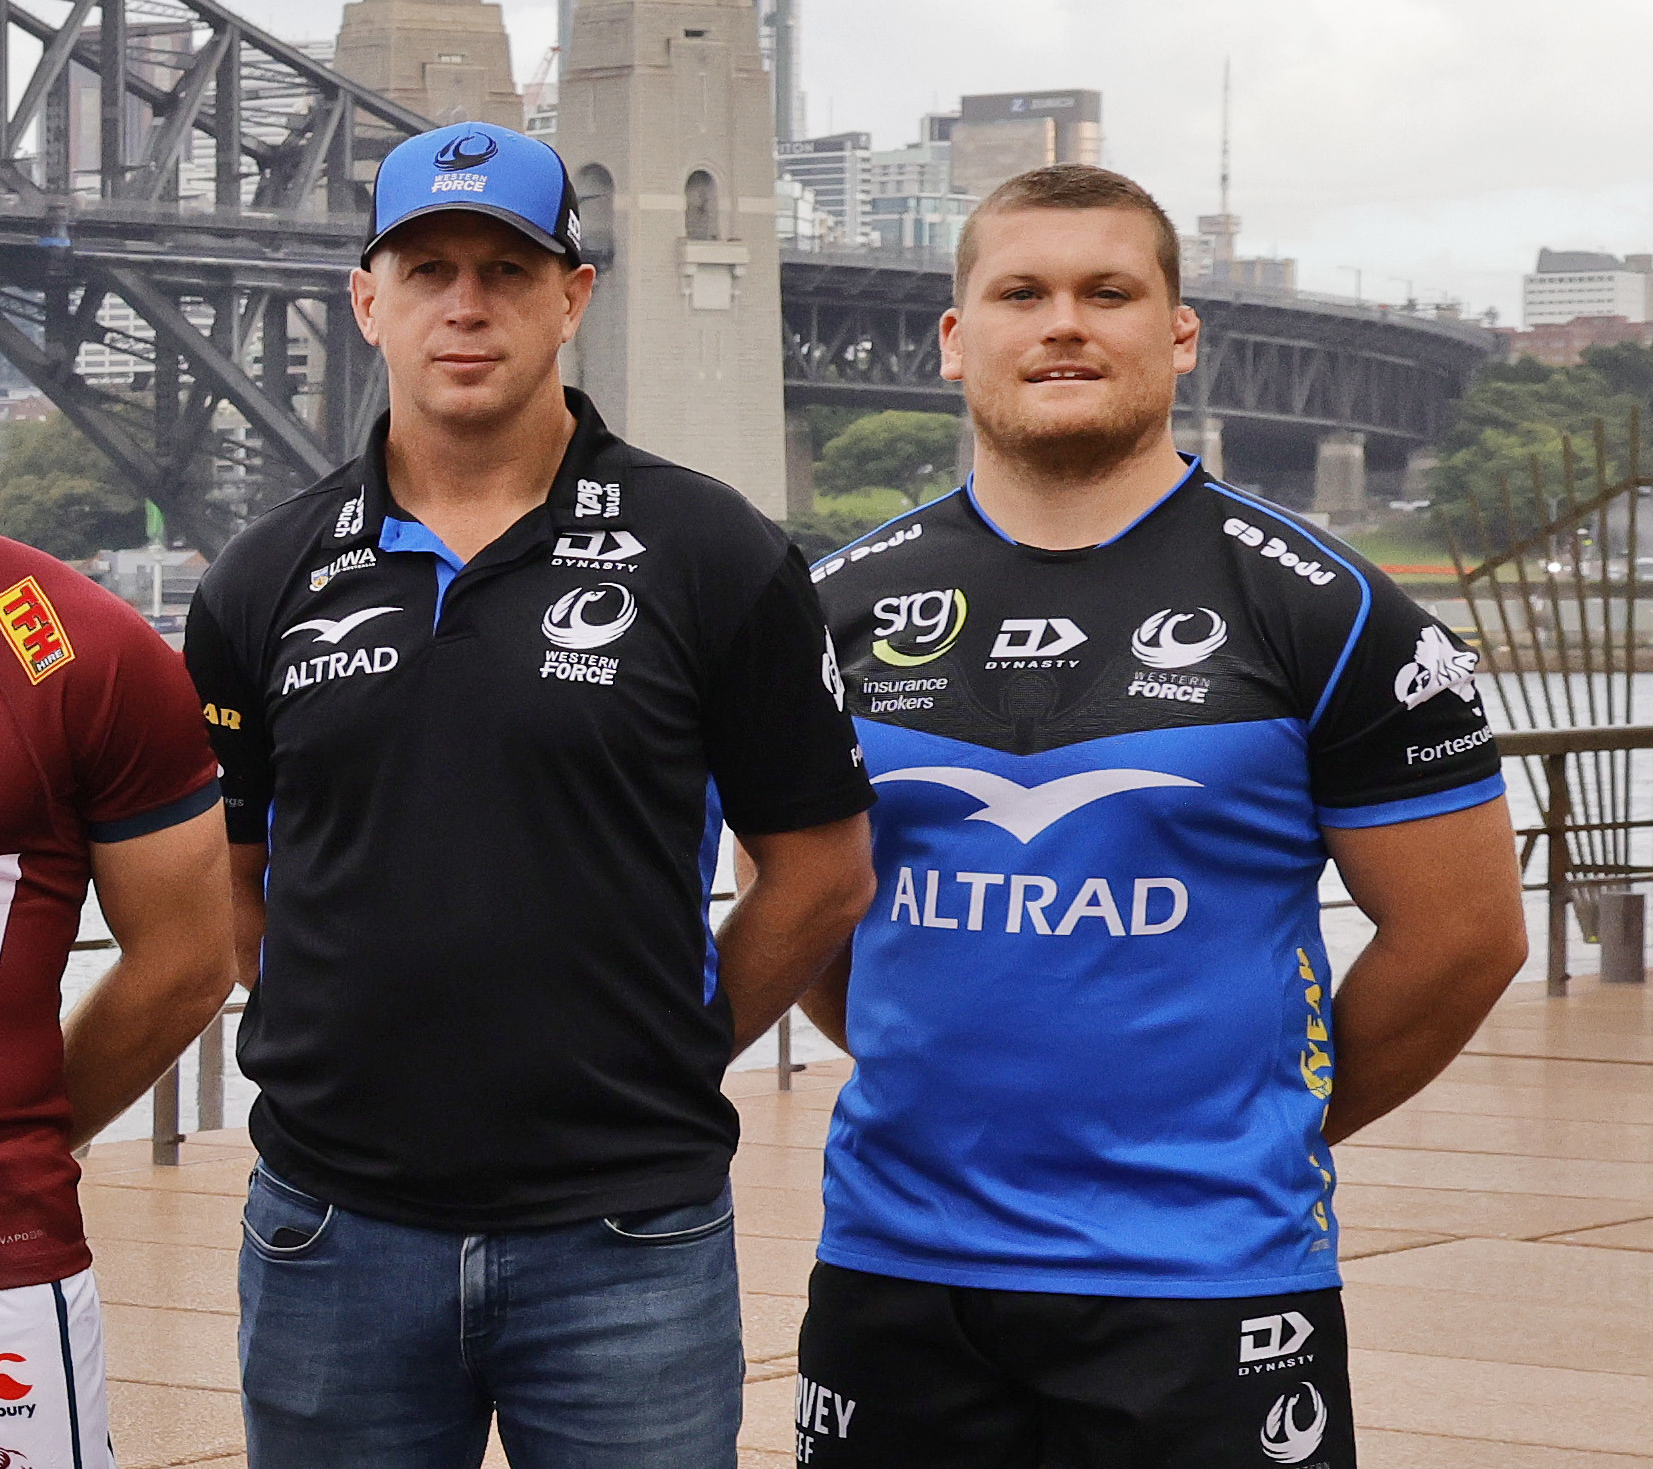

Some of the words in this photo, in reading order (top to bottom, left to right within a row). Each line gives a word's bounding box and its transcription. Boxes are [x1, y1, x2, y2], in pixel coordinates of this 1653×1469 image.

[431, 180, 486, 193] FORCE
[435, 173, 488, 182] WESTERN
[574, 479, 603, 518] TAB
[603, 483, 621, 518] touch
[329, 548, 377, 577] UWA
[551, 558, 639, 573] DYNASTY
[3, 585, 63, 664] TFH
[873, 589, 954, 643] srg
[35, 648, 65, 673] HIRE
[281, 647, 399, 695] ALTRAD
[545, 650, 620, 670] WESTERN
[985, 659, 1082, 670] DYNASTY
[539, 662, 617, 685] FORCE
[1134, 671, 1211, 688] WESTERN
[863, 678, 948, 694] insurance
[1127, 681, 1210, 704] FORCE
[871, 695, 934, 713] brokers
[891, 867, 1189, 937] ALTRAD
[1238, 1354, 1315, 1376] DYNASTY
